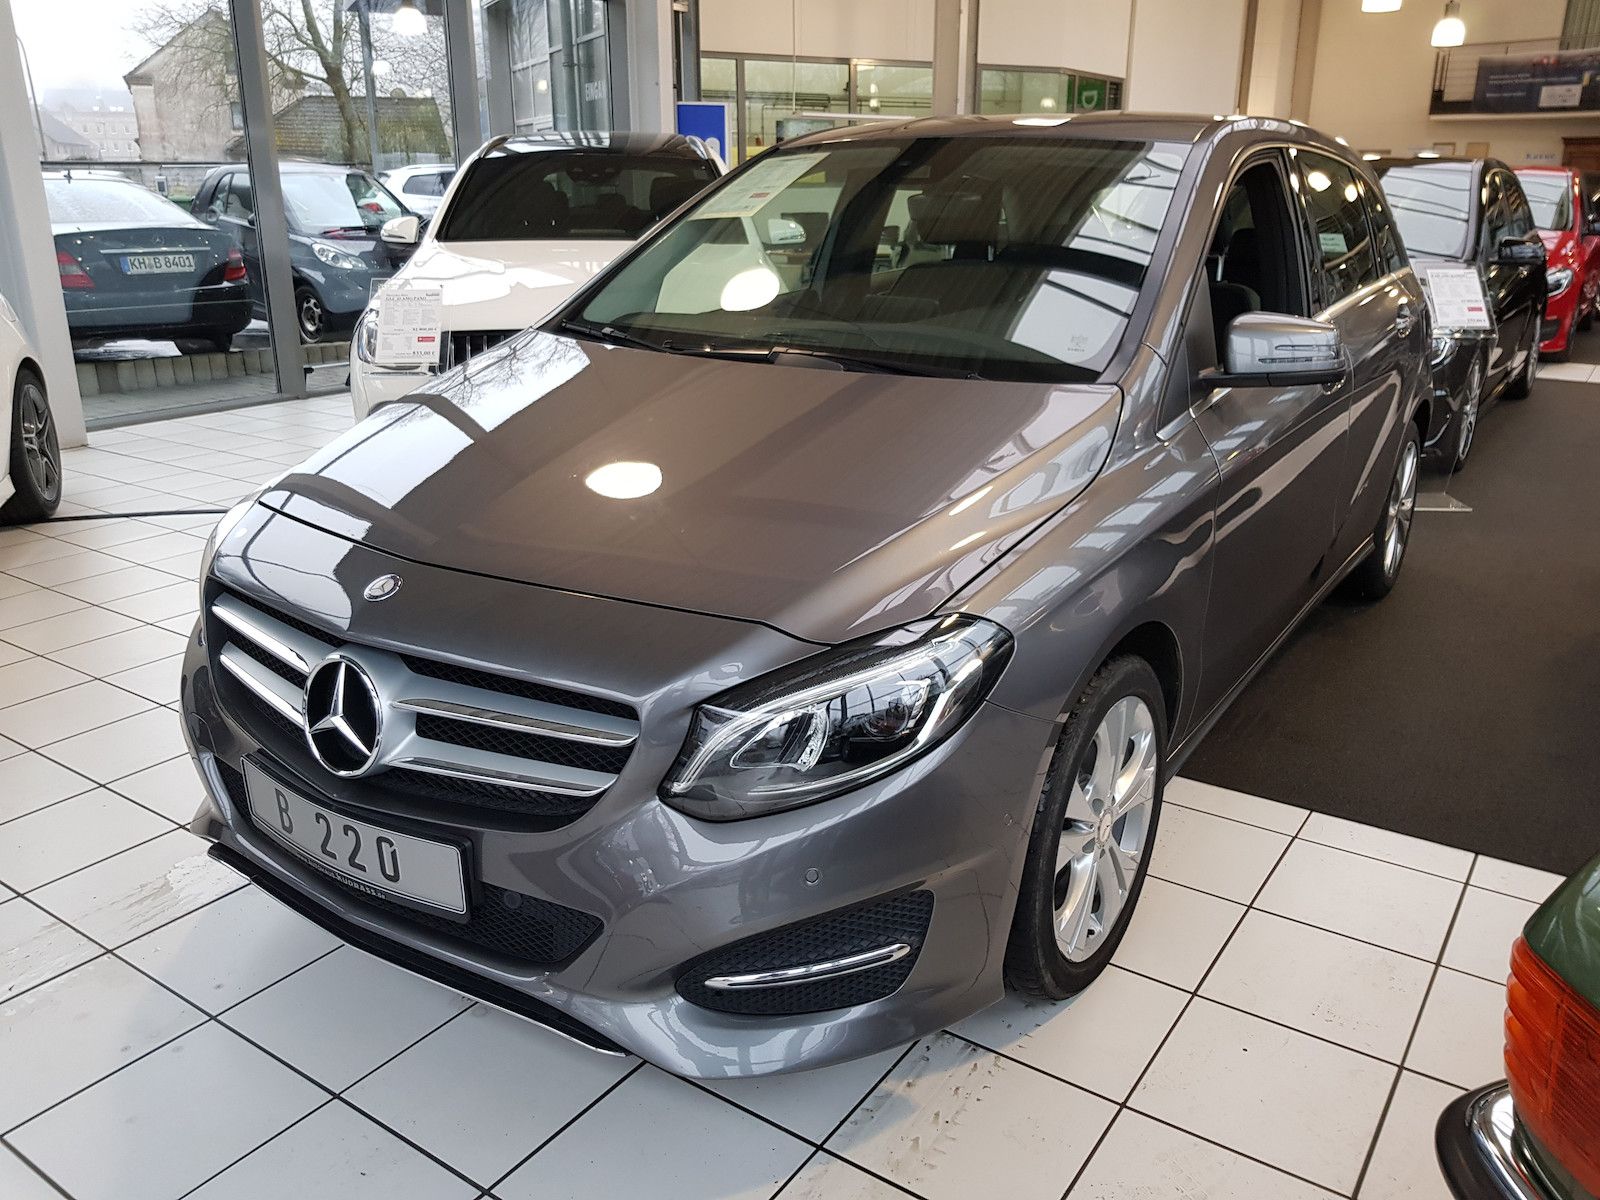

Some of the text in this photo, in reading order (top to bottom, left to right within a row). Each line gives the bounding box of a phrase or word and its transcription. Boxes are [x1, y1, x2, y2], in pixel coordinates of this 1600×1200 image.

[129, 256, 194, 270] KH B 8401
[275, 787, 400, 883] B 220
